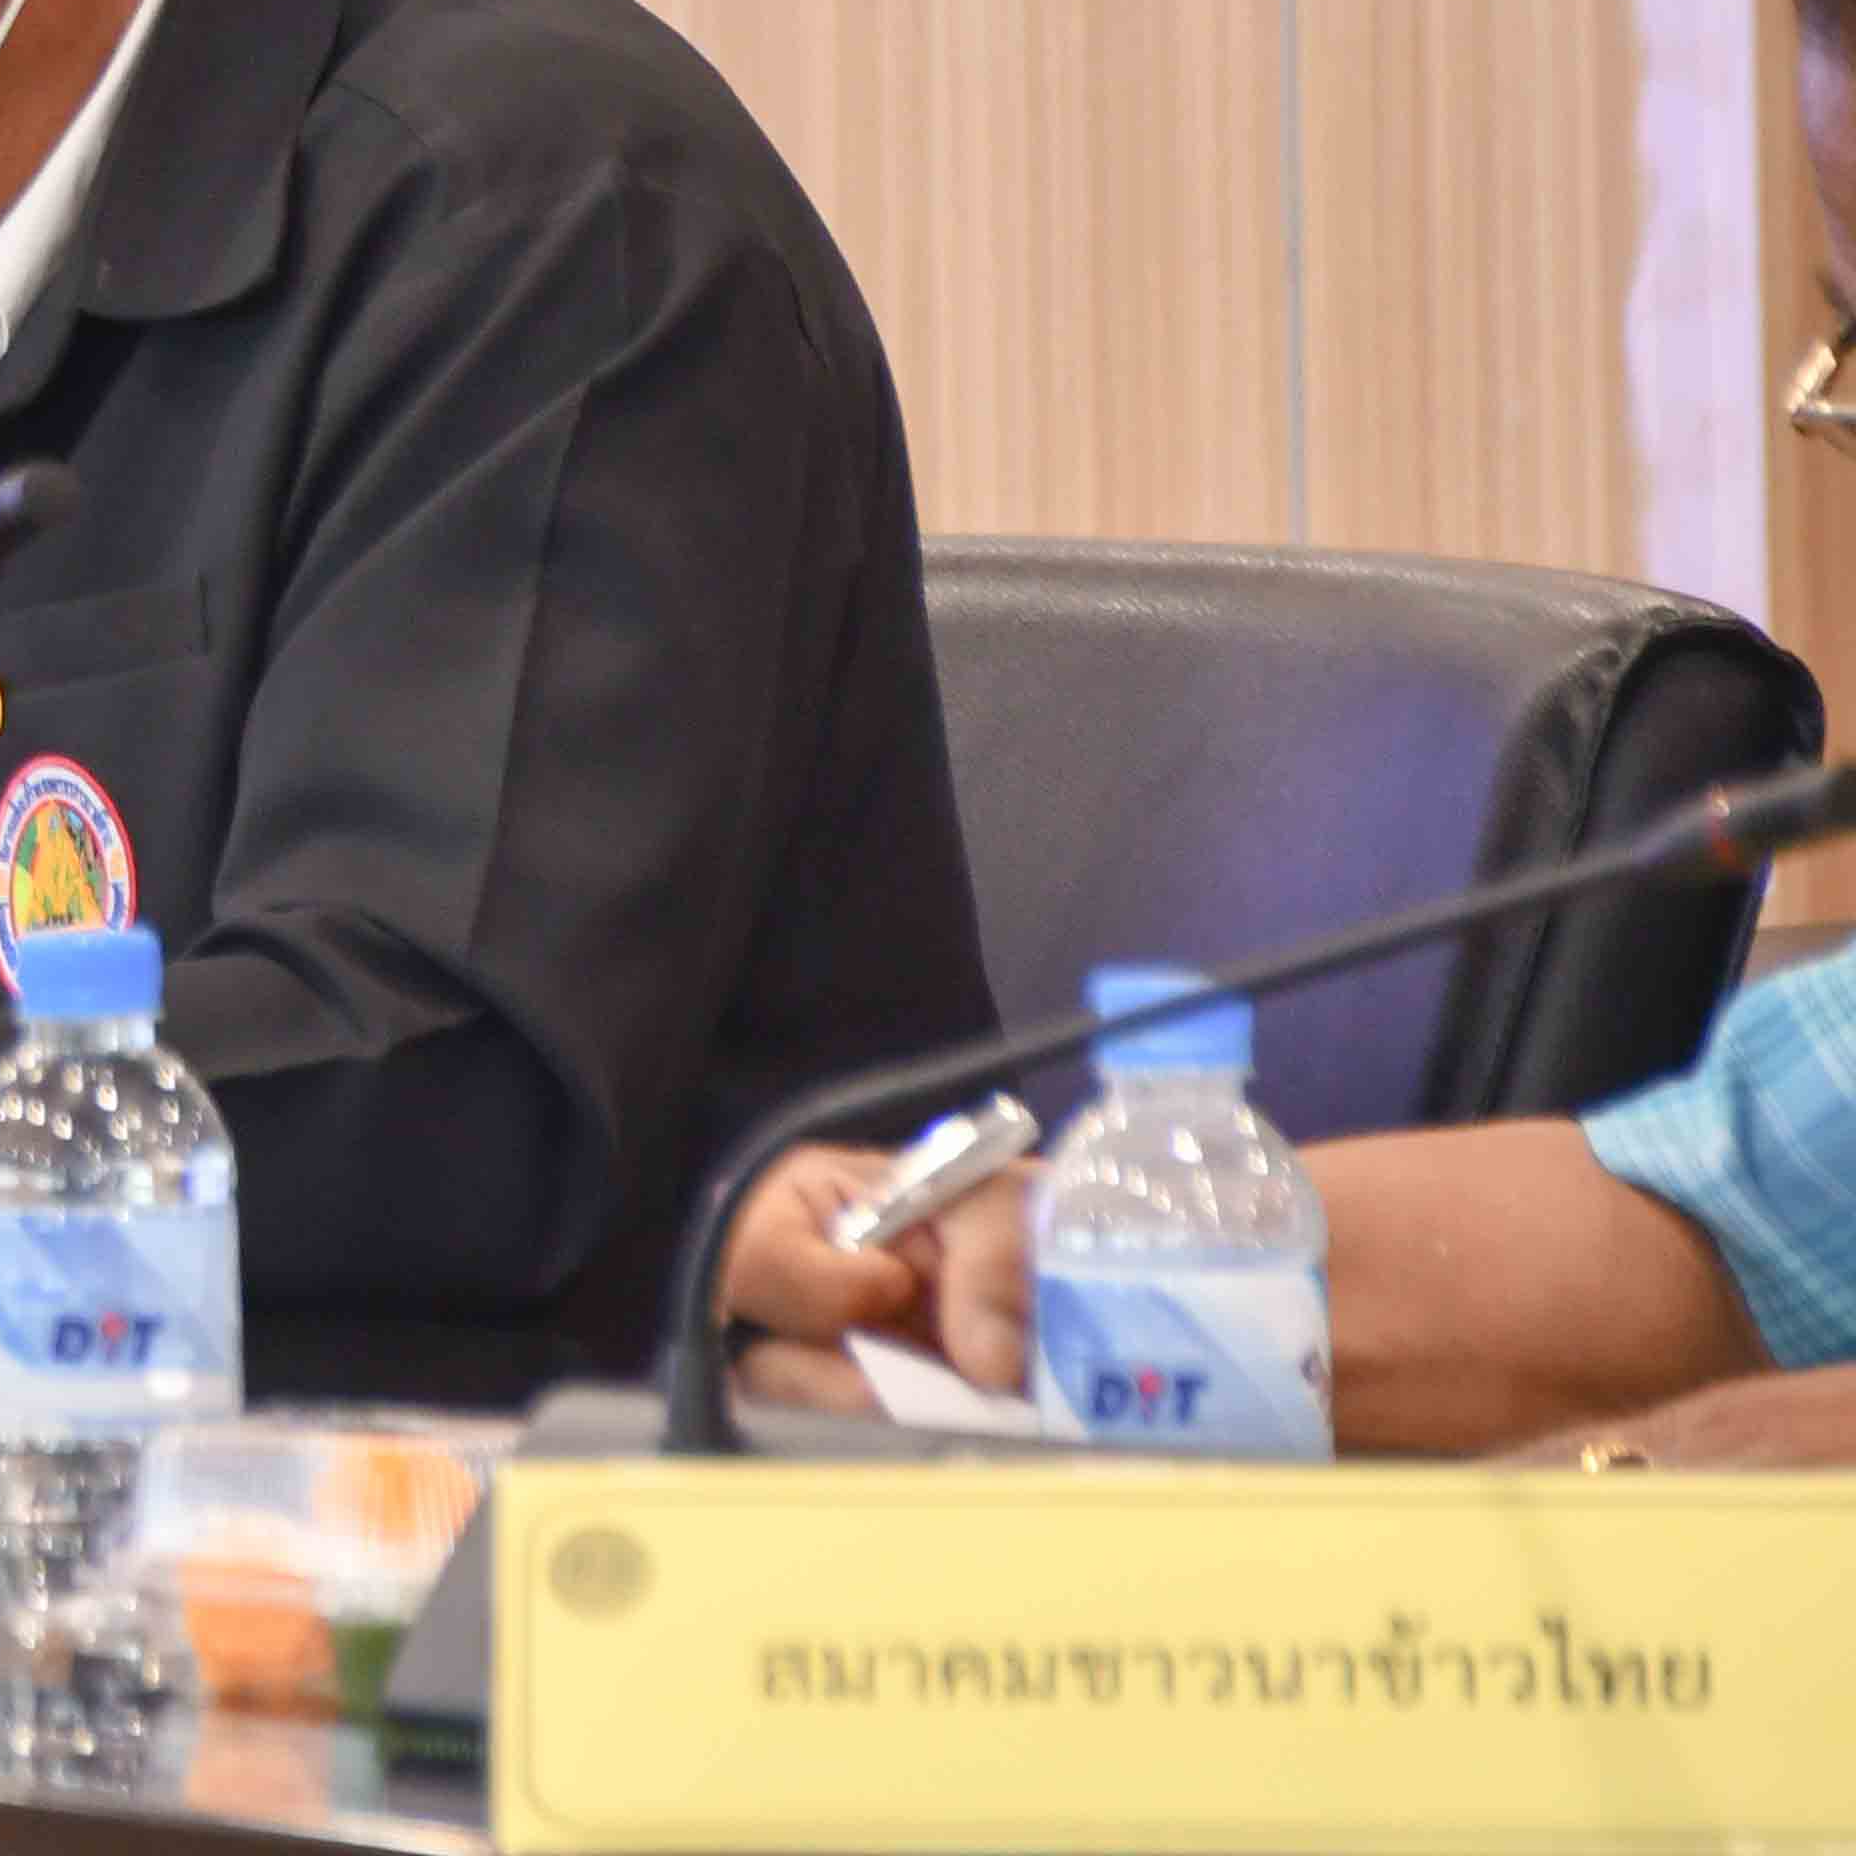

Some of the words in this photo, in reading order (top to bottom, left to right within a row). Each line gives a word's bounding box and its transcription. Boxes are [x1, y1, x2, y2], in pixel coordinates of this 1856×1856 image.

[759, 1610, 1713, 1710] สมาคมชาวนาข้าวไทย
